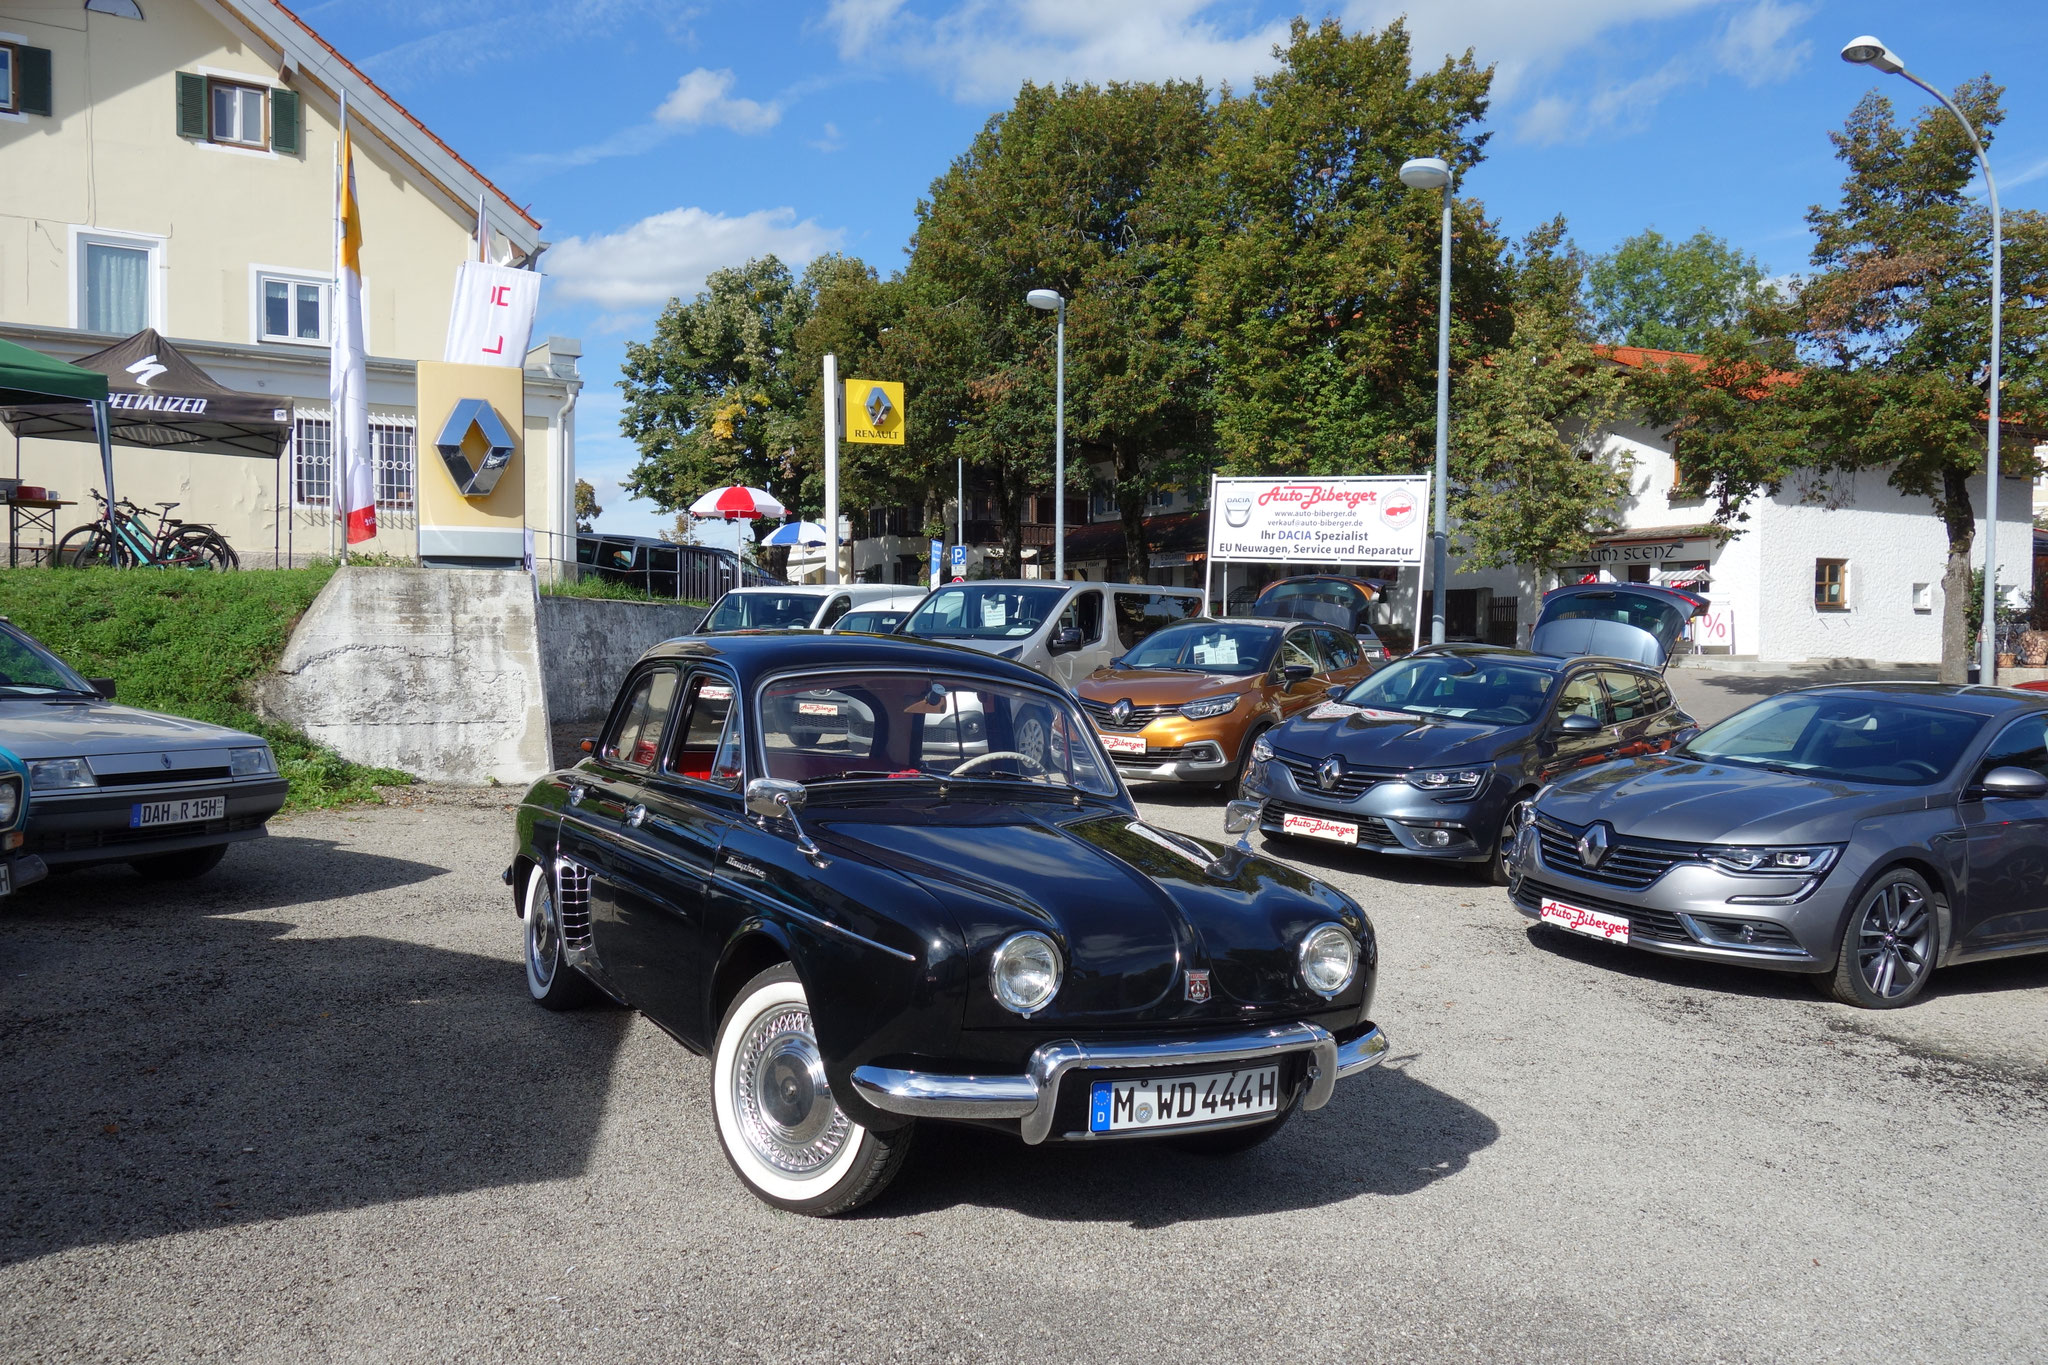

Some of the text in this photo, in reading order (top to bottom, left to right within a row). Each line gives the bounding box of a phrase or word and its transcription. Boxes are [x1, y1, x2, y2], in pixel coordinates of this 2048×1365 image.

[855, 429, 899, 440] RENAULT
[1258, 486, 1377, 510] Auto-Biberger
[1274, 510, 1357, 519] www.auto-biberger.de
[1267, 519, 1363, 528] verkauf@auto-biberger.de
[1260, 530, 1369, 543] Ihr DACIA Spezialist
[954, 548, 963, 563] P
[1219, 543, 1414, 557] EU Neuwagen, Service und Reparatur
[800, 703, 837, 713] Auto-Biberger
[1101, 736, 1144, 750] to-Biberger
[142, 799, 217, 824] DAH R 15H
[1284, 816, 1355, 837] Auto-Biberger
[1540, 902, 1630, 938] Auto-Biberger
[1113, 1070, 1276, 1124] M WD 444H
[1097, 1111, 1106, 1123] D
